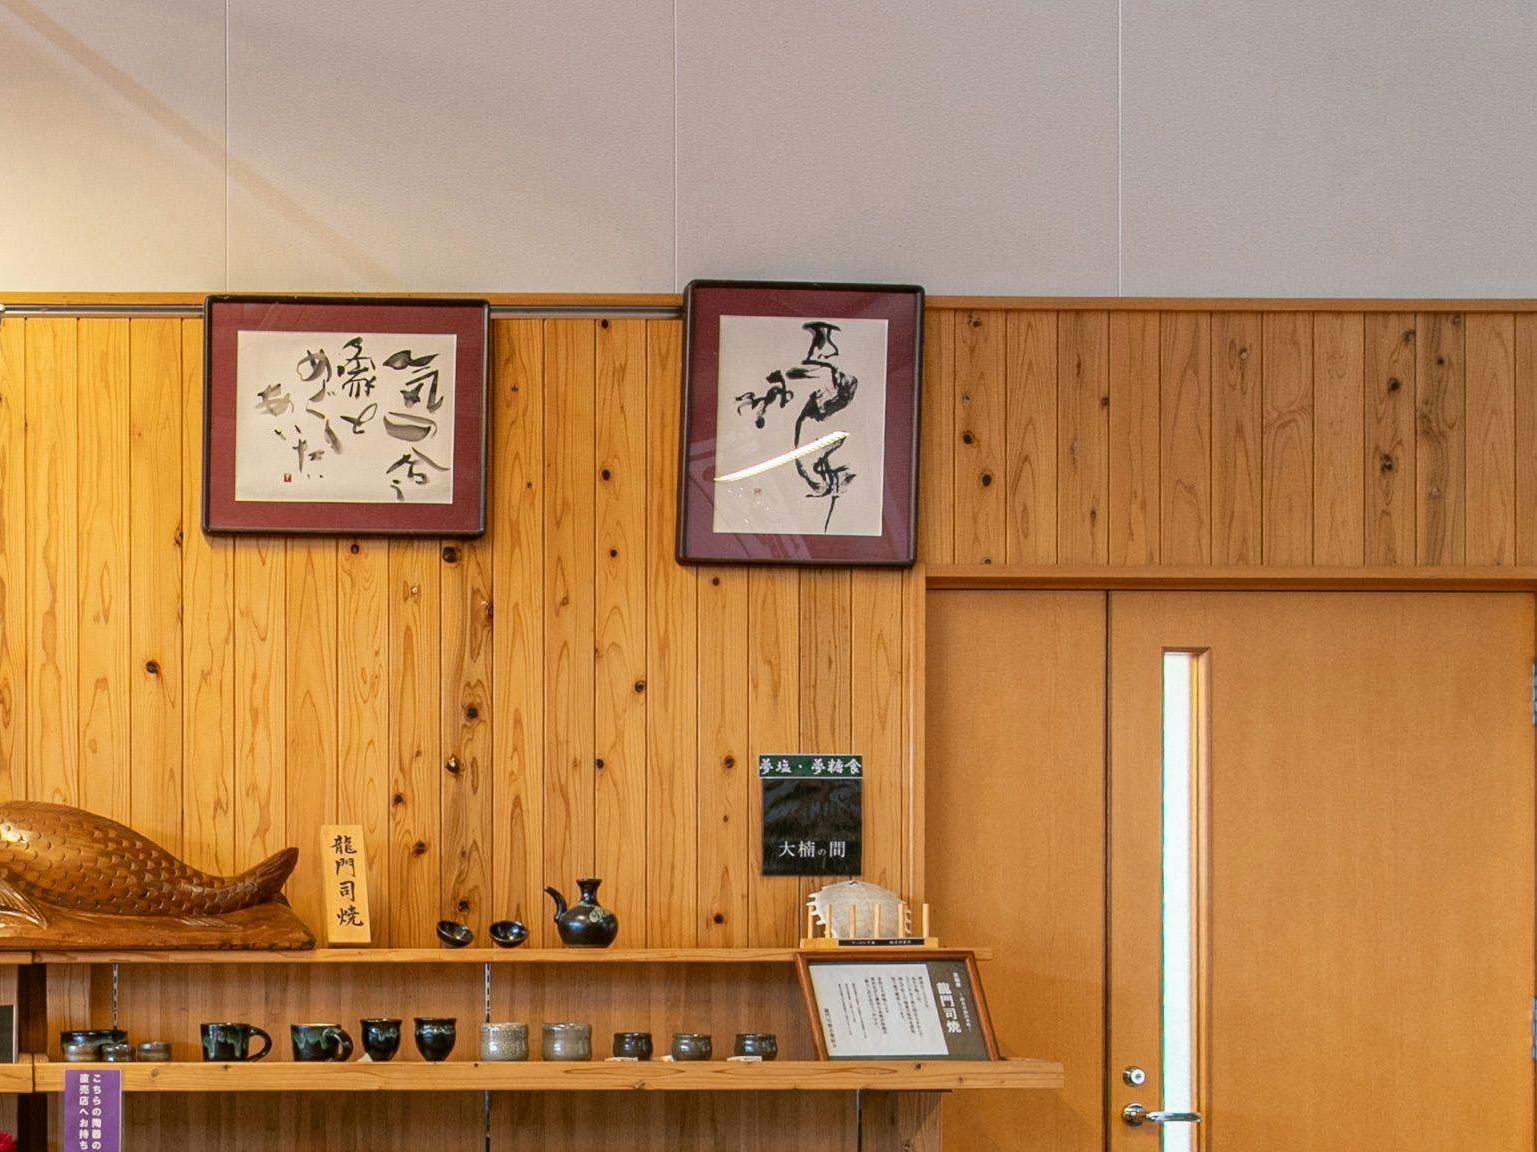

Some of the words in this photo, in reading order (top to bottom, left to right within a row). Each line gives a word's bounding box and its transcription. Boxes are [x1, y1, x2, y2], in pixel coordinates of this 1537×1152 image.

[778, 840, 846, 858] 大楠の間
[331, 834, 364, 927] 龍門司焼
